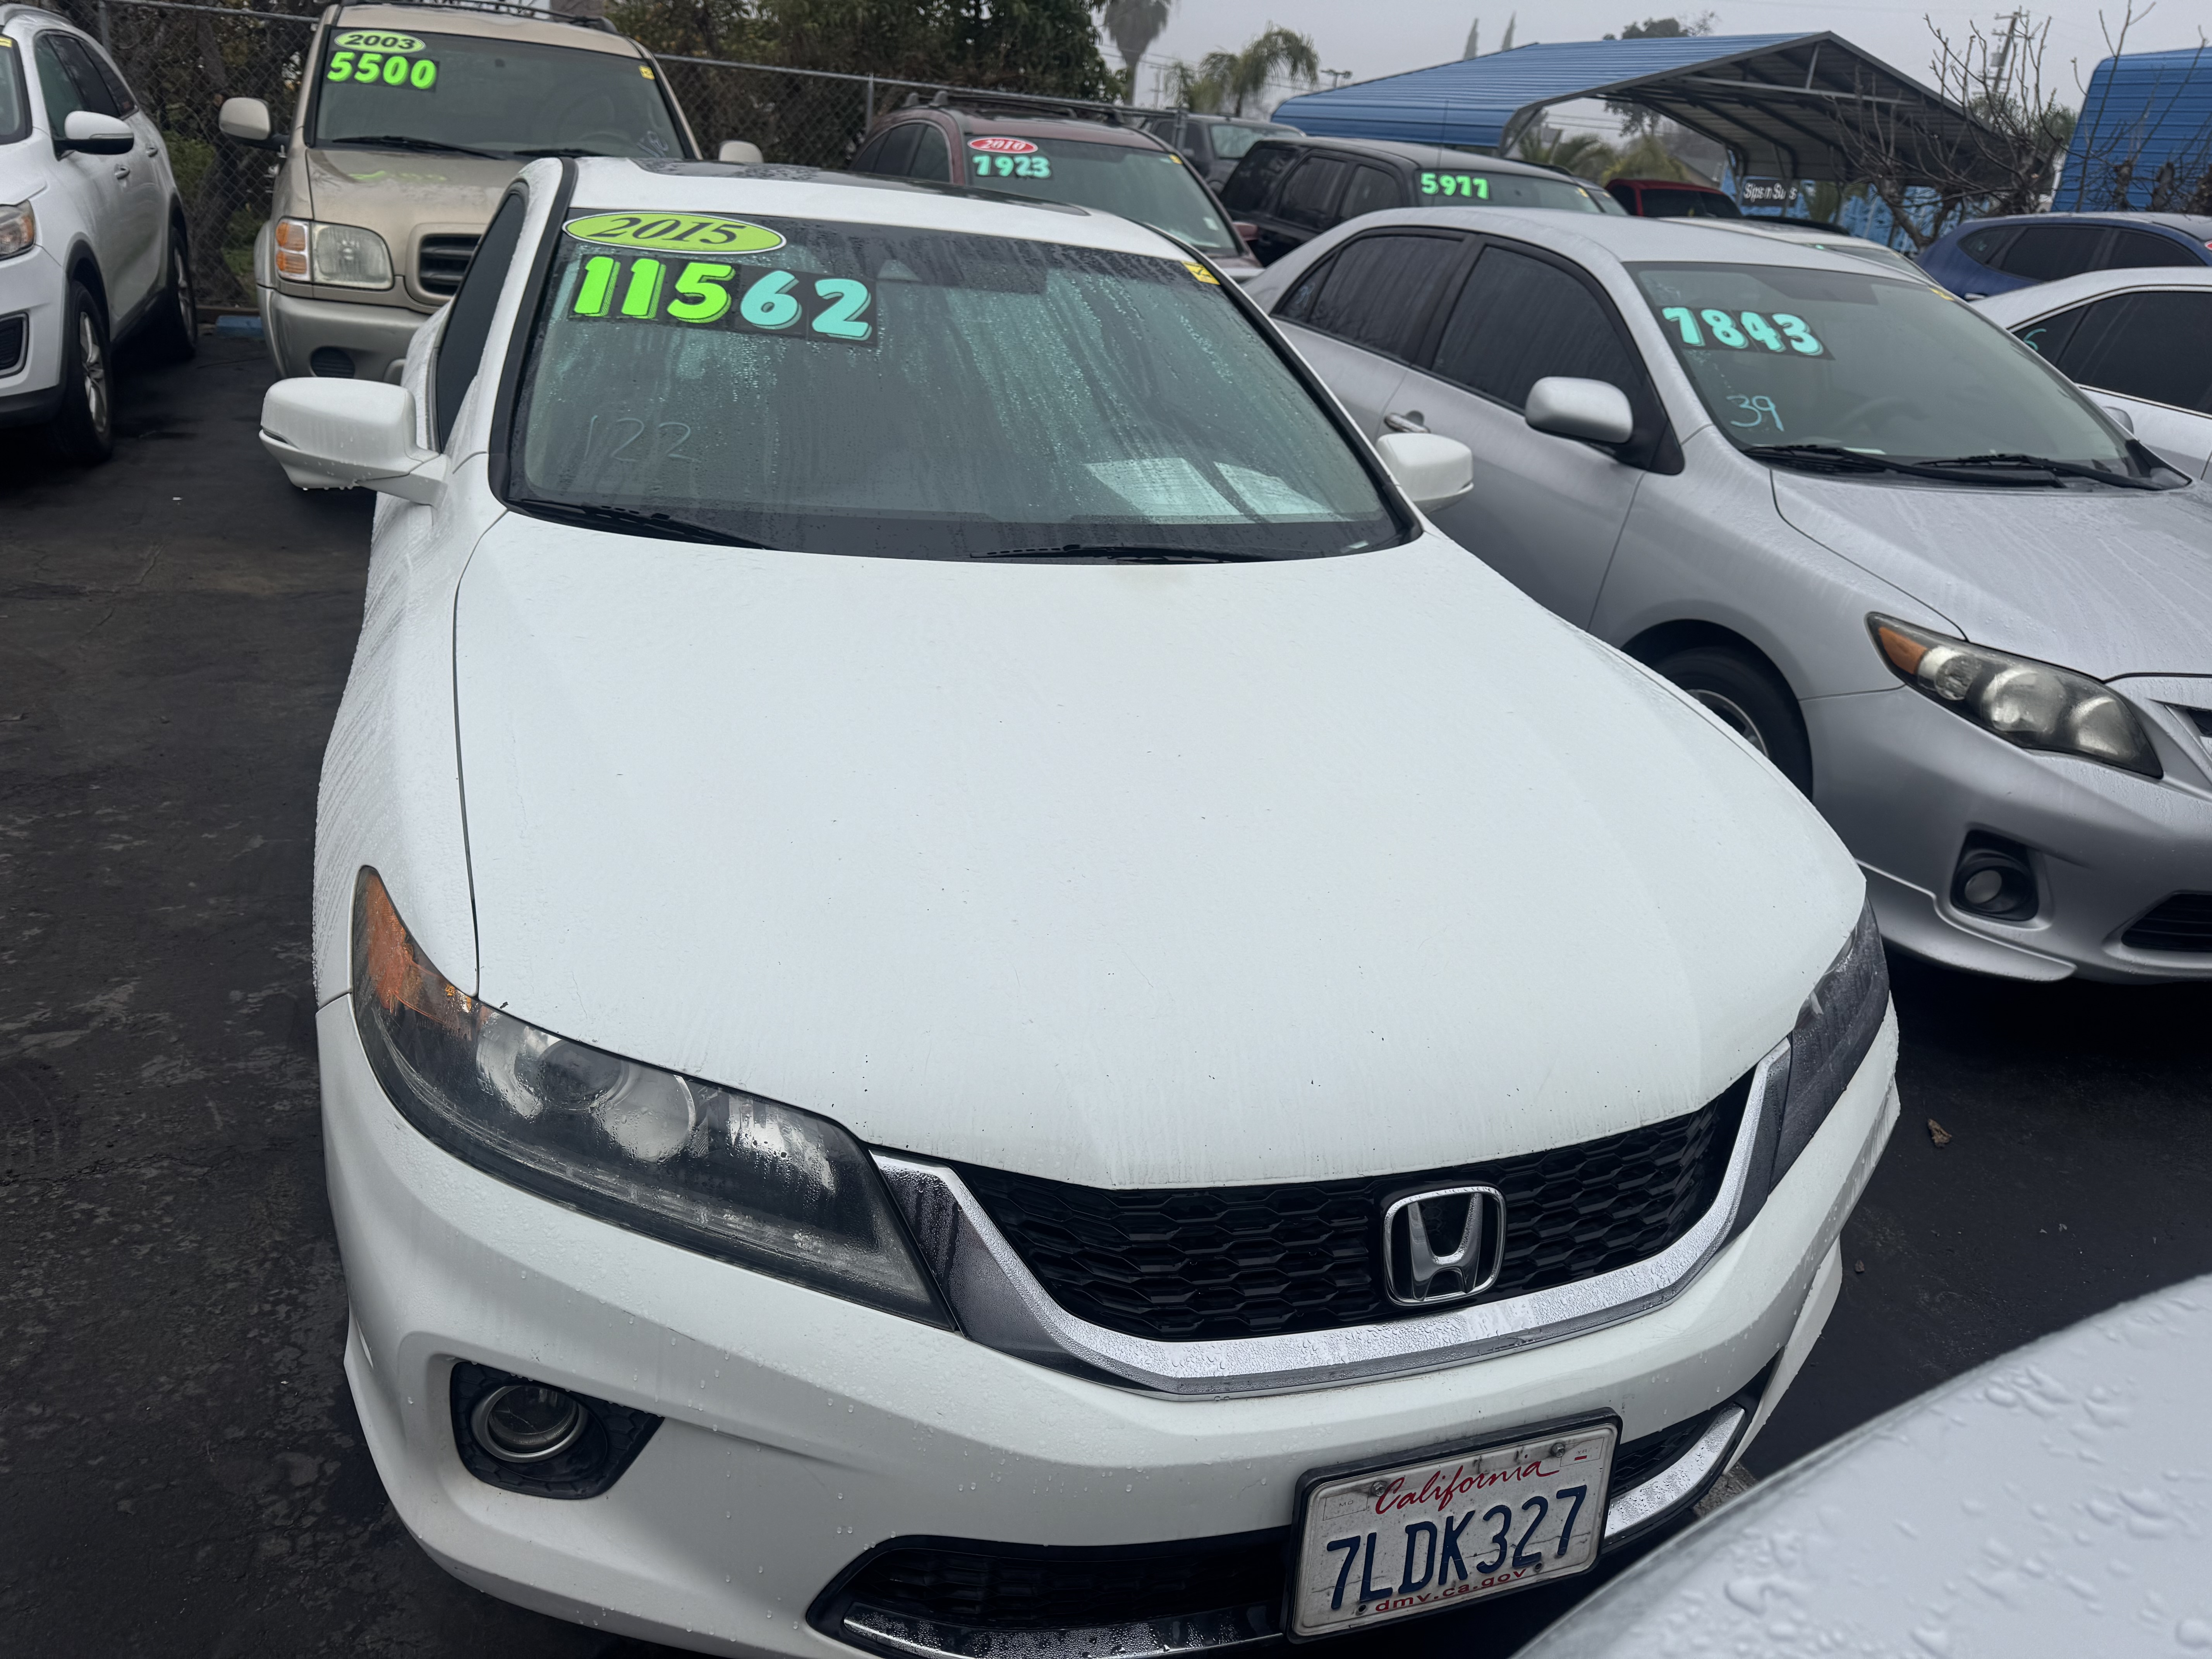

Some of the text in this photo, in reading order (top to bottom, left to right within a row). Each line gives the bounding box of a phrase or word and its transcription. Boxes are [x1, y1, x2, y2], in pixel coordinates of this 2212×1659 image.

[344, 34, 416, 50] 2003
[327, 52, 437, 89] 5500
[980, 139, 1027, 151] 2010
[972, 154, 1051, 178] 7923
[1421, 172, 1489, 200] 5977
[586, 217, 748, 246] 2015
[573, 256, 872, 341] 11562
[1662, 307, 1824, 356] 7843
[1726, 394, 1784, 432] 39
[582, 415, 702, 462] 122
[1375, 1455, 1560, 1515] California
[1326, 1484, 1588, 1610] 7LDK327
[1375, 1568, 1527, 1612] dmv.ca.gov
